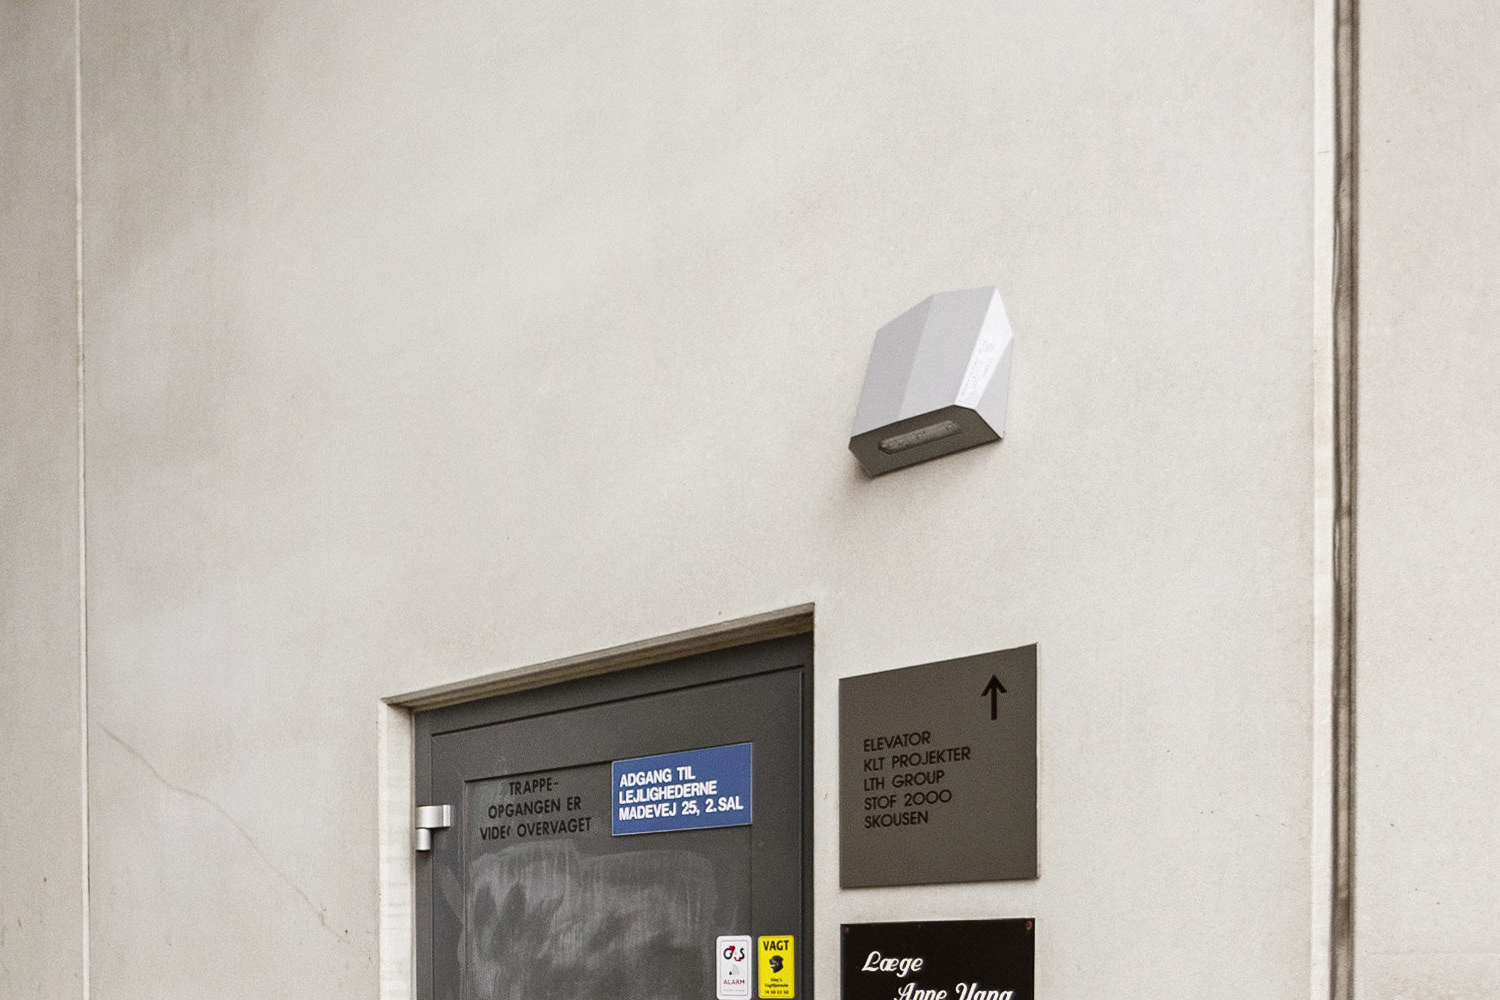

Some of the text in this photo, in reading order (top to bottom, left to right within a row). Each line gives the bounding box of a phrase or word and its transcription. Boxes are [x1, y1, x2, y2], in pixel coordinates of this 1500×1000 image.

[863, 731, 931, 752] ELEVATOR
[863, 746, 971, 772] KLT PROJEKTER
[509, 778, 559, 796] TRAPPE-
[620, 766, 696, 788] ADGANG TIL
[863, 770, 945, 792] LTH GROUP
[619, 780, 718, 804] LEJLIGHEDERNE
[863, 789, 952, 811] STOF 2000
[488, 795, 582, 819] OPGANGEN ER
[619, 801, 677, 821] MADEVEJ
[681, 800, 701, 818] 25,
[517, 816, 592, 838] OVERVAGET
[863, 811, 929, 829] SKOUSEN
[762, 940, 790, 951] VAGT
[861, 950, 924, 978] Læge
